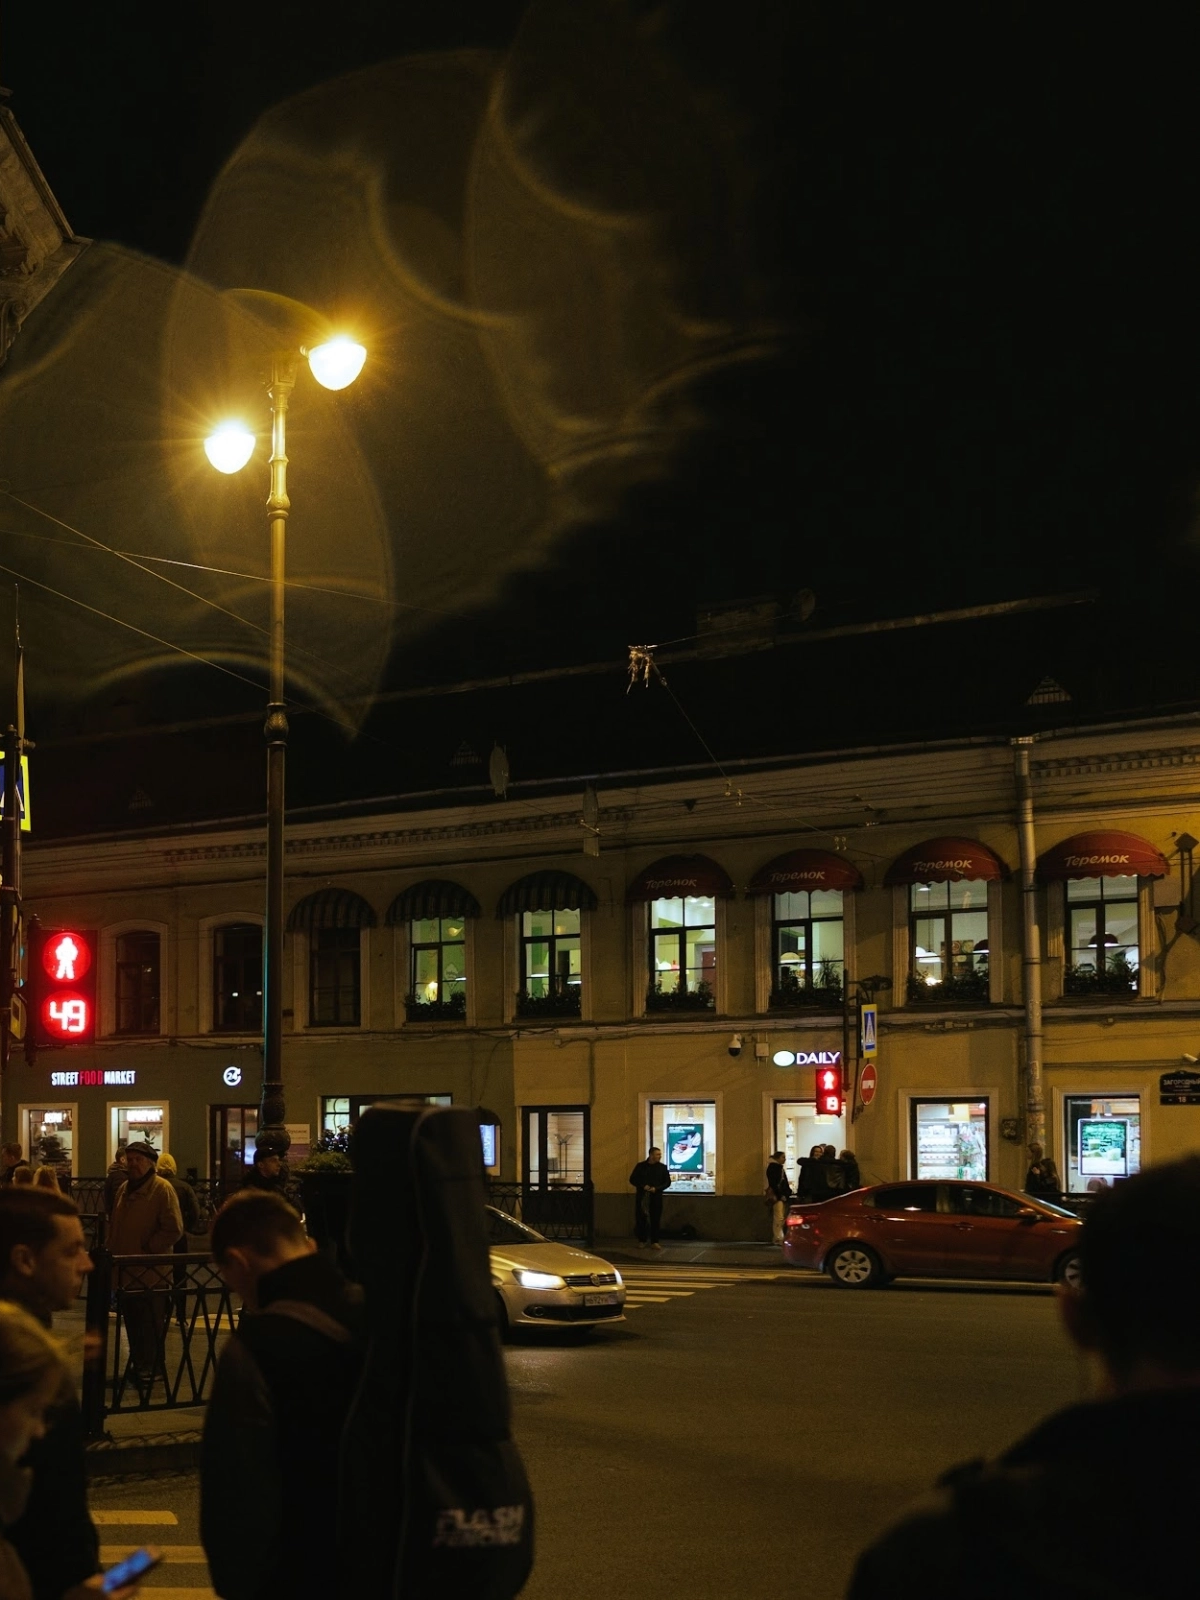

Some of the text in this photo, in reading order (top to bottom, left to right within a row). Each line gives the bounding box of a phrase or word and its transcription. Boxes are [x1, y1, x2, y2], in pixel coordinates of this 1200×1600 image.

[913, 858, 972, 872] Теремок
[1064, 854, 1129, 868] Теремок
[769, 870, 825, 882] Теремок
[645, 878, 697, 889] Теремок
[50, 1000, 86, 1032] 49
[796, 1052, 840, 1065] DAILY
[51, 1070, 135, 1087] STREET FOOD MARKET
